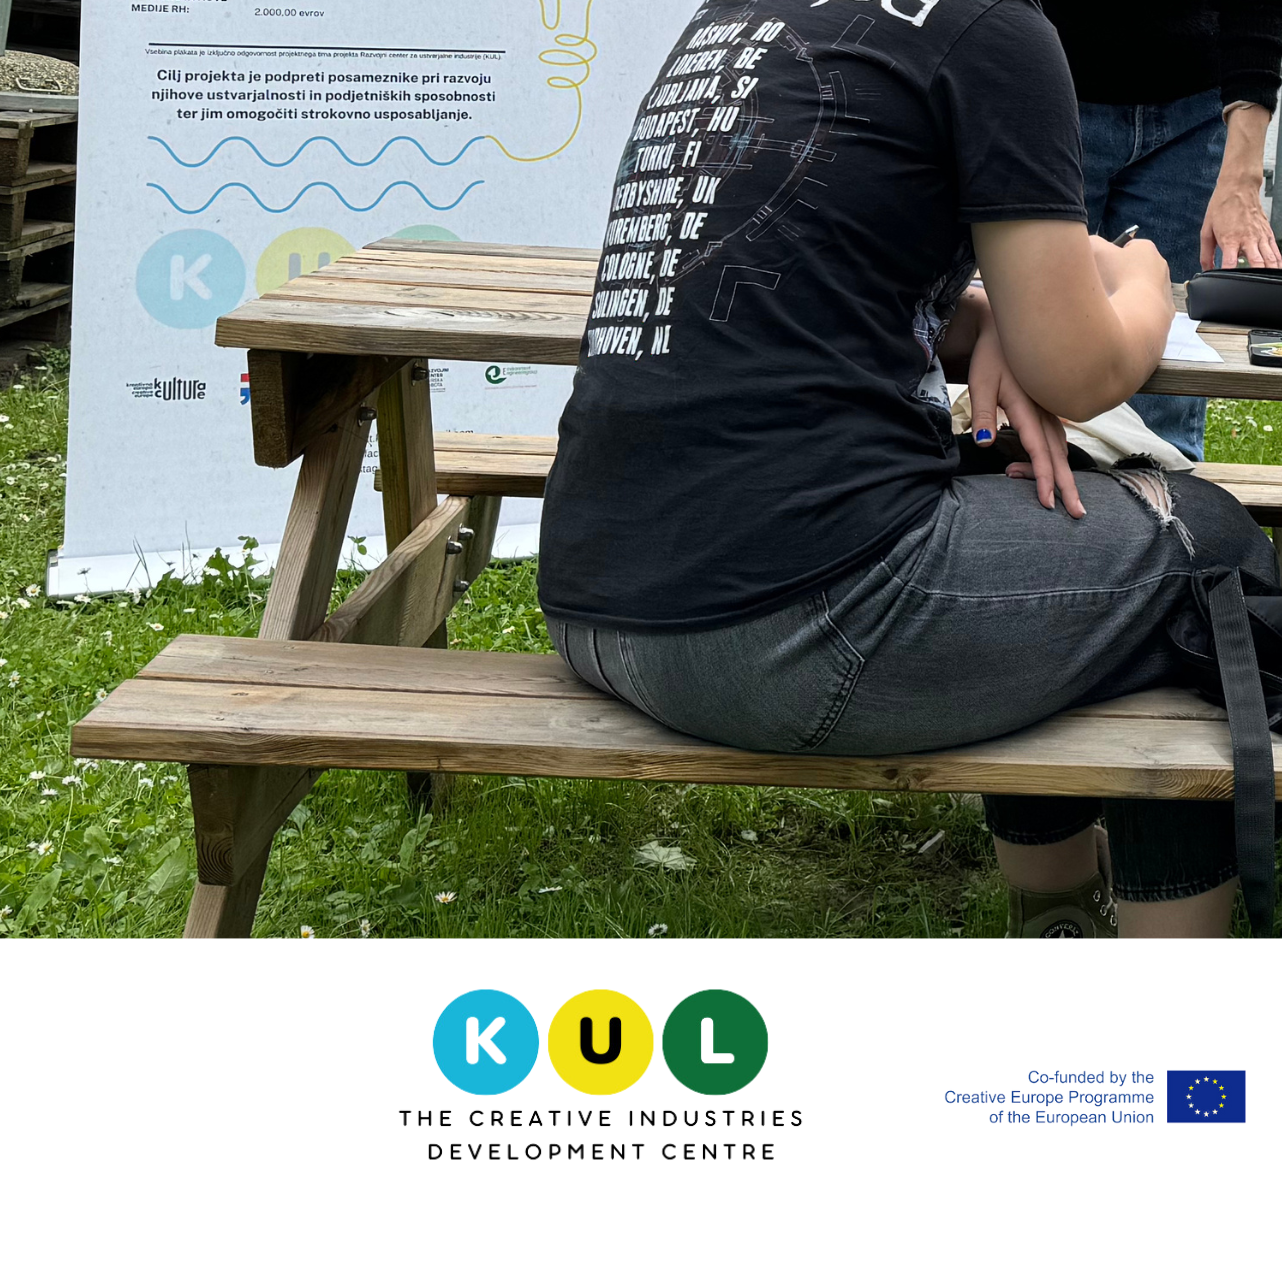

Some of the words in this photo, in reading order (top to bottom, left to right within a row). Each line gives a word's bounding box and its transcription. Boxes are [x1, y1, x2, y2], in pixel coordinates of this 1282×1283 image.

[132, 4, 169, 13] MEDIJE
[172, 5, 189, 13] RH:
[750, 22, 785, 42] RO
[736, 47, 768, 70] BE
[157, 70, 181, 82] Cilj
[185, 70, 245, 83] projekta
[248, 71, 261, 83] je
[265, 71, 324, 84] podpreti
[328, 72, 418, 84] posameznike
[422, 73, 440, 85] pri
[444, 74, 491, 85] razvoju
[152, 88, 203, 101] njihove
[207, 89, 306, 102] ustvarjalnosti
[309, 90, 322, 100] in
[326, 90, 411, 103] podjetniških
[414, 91, 496, 103] sposobnosti
[646, 76, 720, 112] LJUBLJANA,
[731, 76, 759, 102] SI
[177, 108, 198, 119] ter
[200, 108, 222, 121] jim
[226, 108, 298, 121] omogočiti
[301, 108, 371, 120] strokovno
[374, 109, 472, 122] usposabljanje.
[632, 107, 702, 143] BUDAPEST,
[706, 106, 740, 133] HU
[633, 142, 676, 175] TURKU,
[682, 141, 702, 168] FI
[693, 176, 721, 205] UK
[679, 213, 708, 240] DE
[601, 250, 654, 285] COLOGNE,
[659, 249, 681, 277] DE
[592, 288, 650, 323] SOLINGEN,
[655, 287, 675, 316] DE
[651, 325, 672, 355] NL
